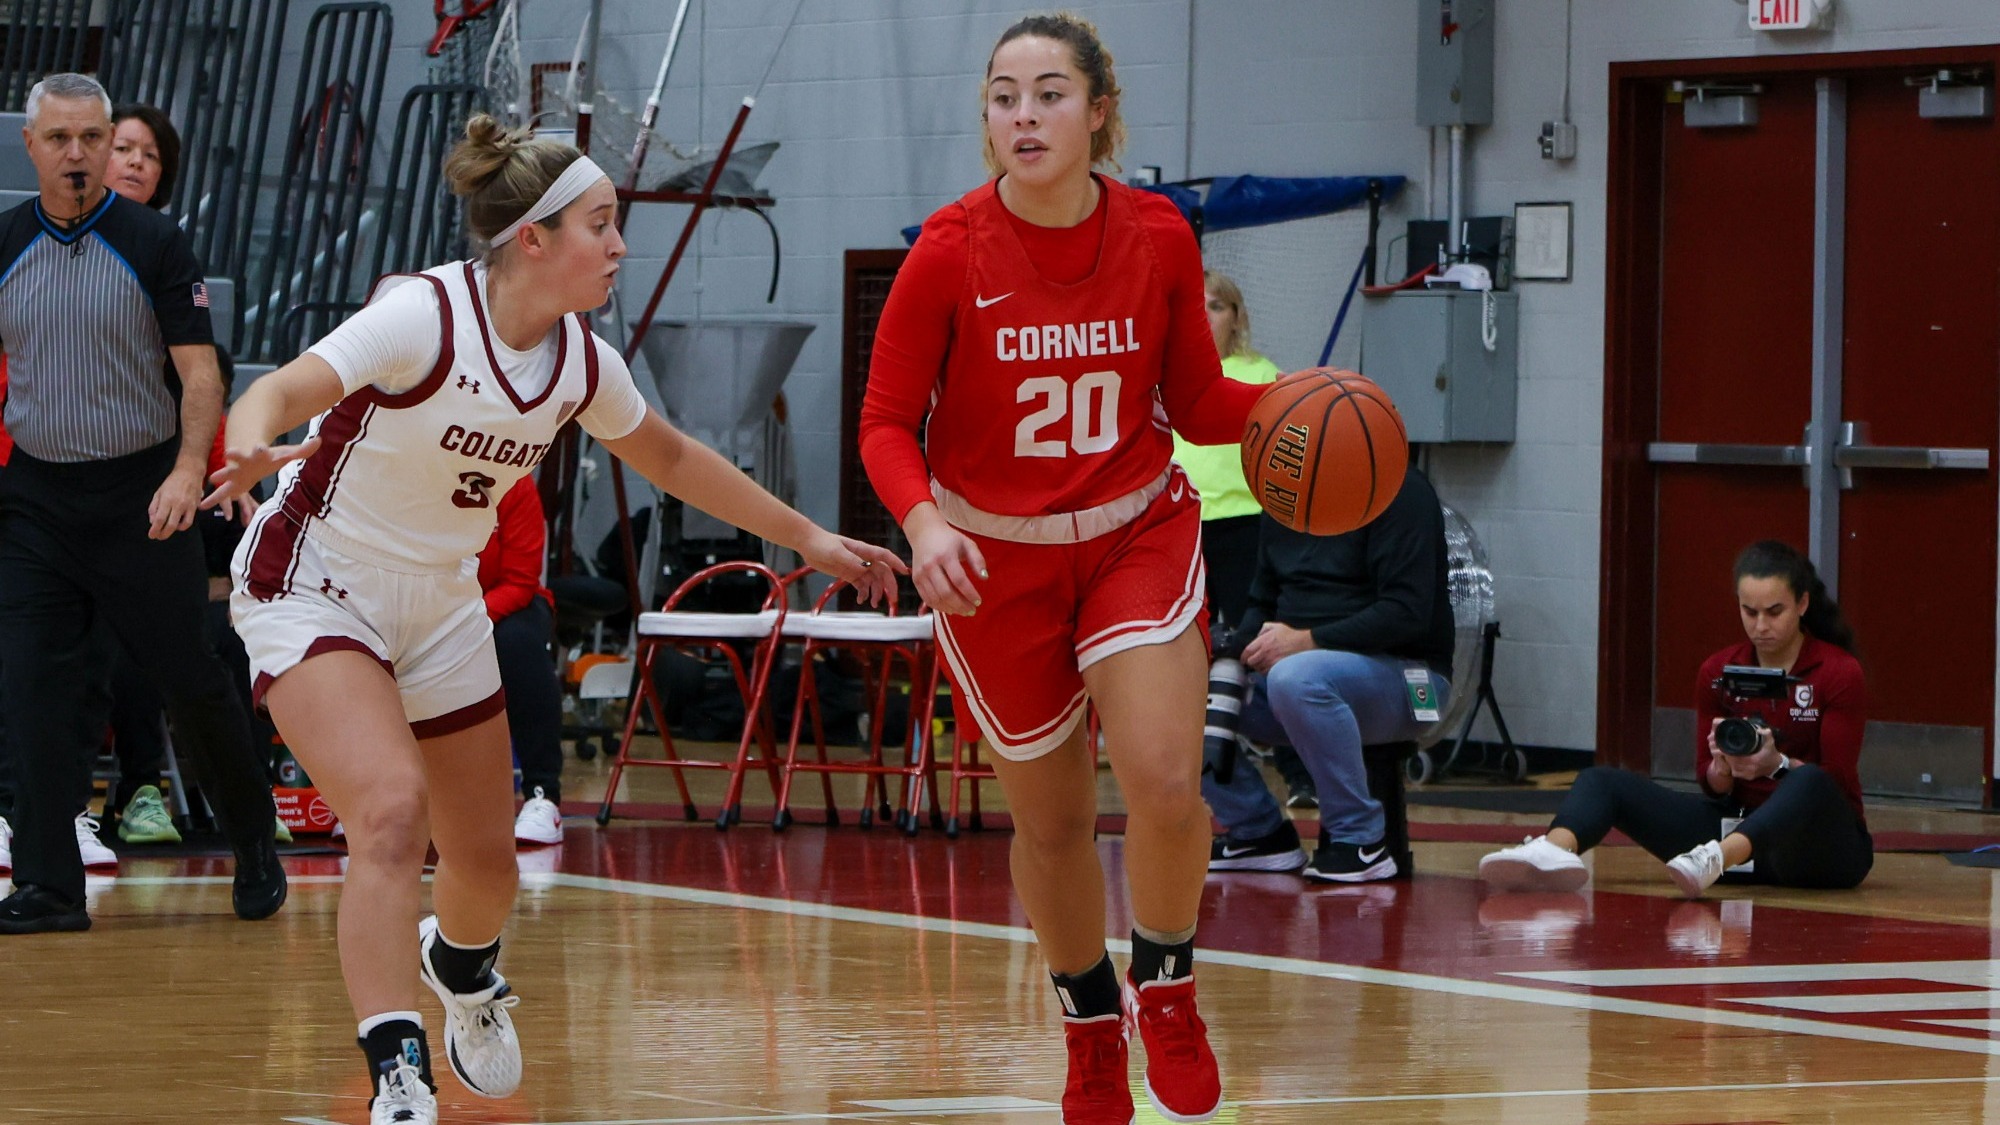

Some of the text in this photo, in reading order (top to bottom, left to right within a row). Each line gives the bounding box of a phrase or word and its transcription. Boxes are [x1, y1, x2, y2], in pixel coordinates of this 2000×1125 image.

[996, 318, 1140, 361] CORNELL
[1014, 370, 1122, 458] 20
[1267, 424, 1310, 481] THE
[451, 471, 496, 509] 3
